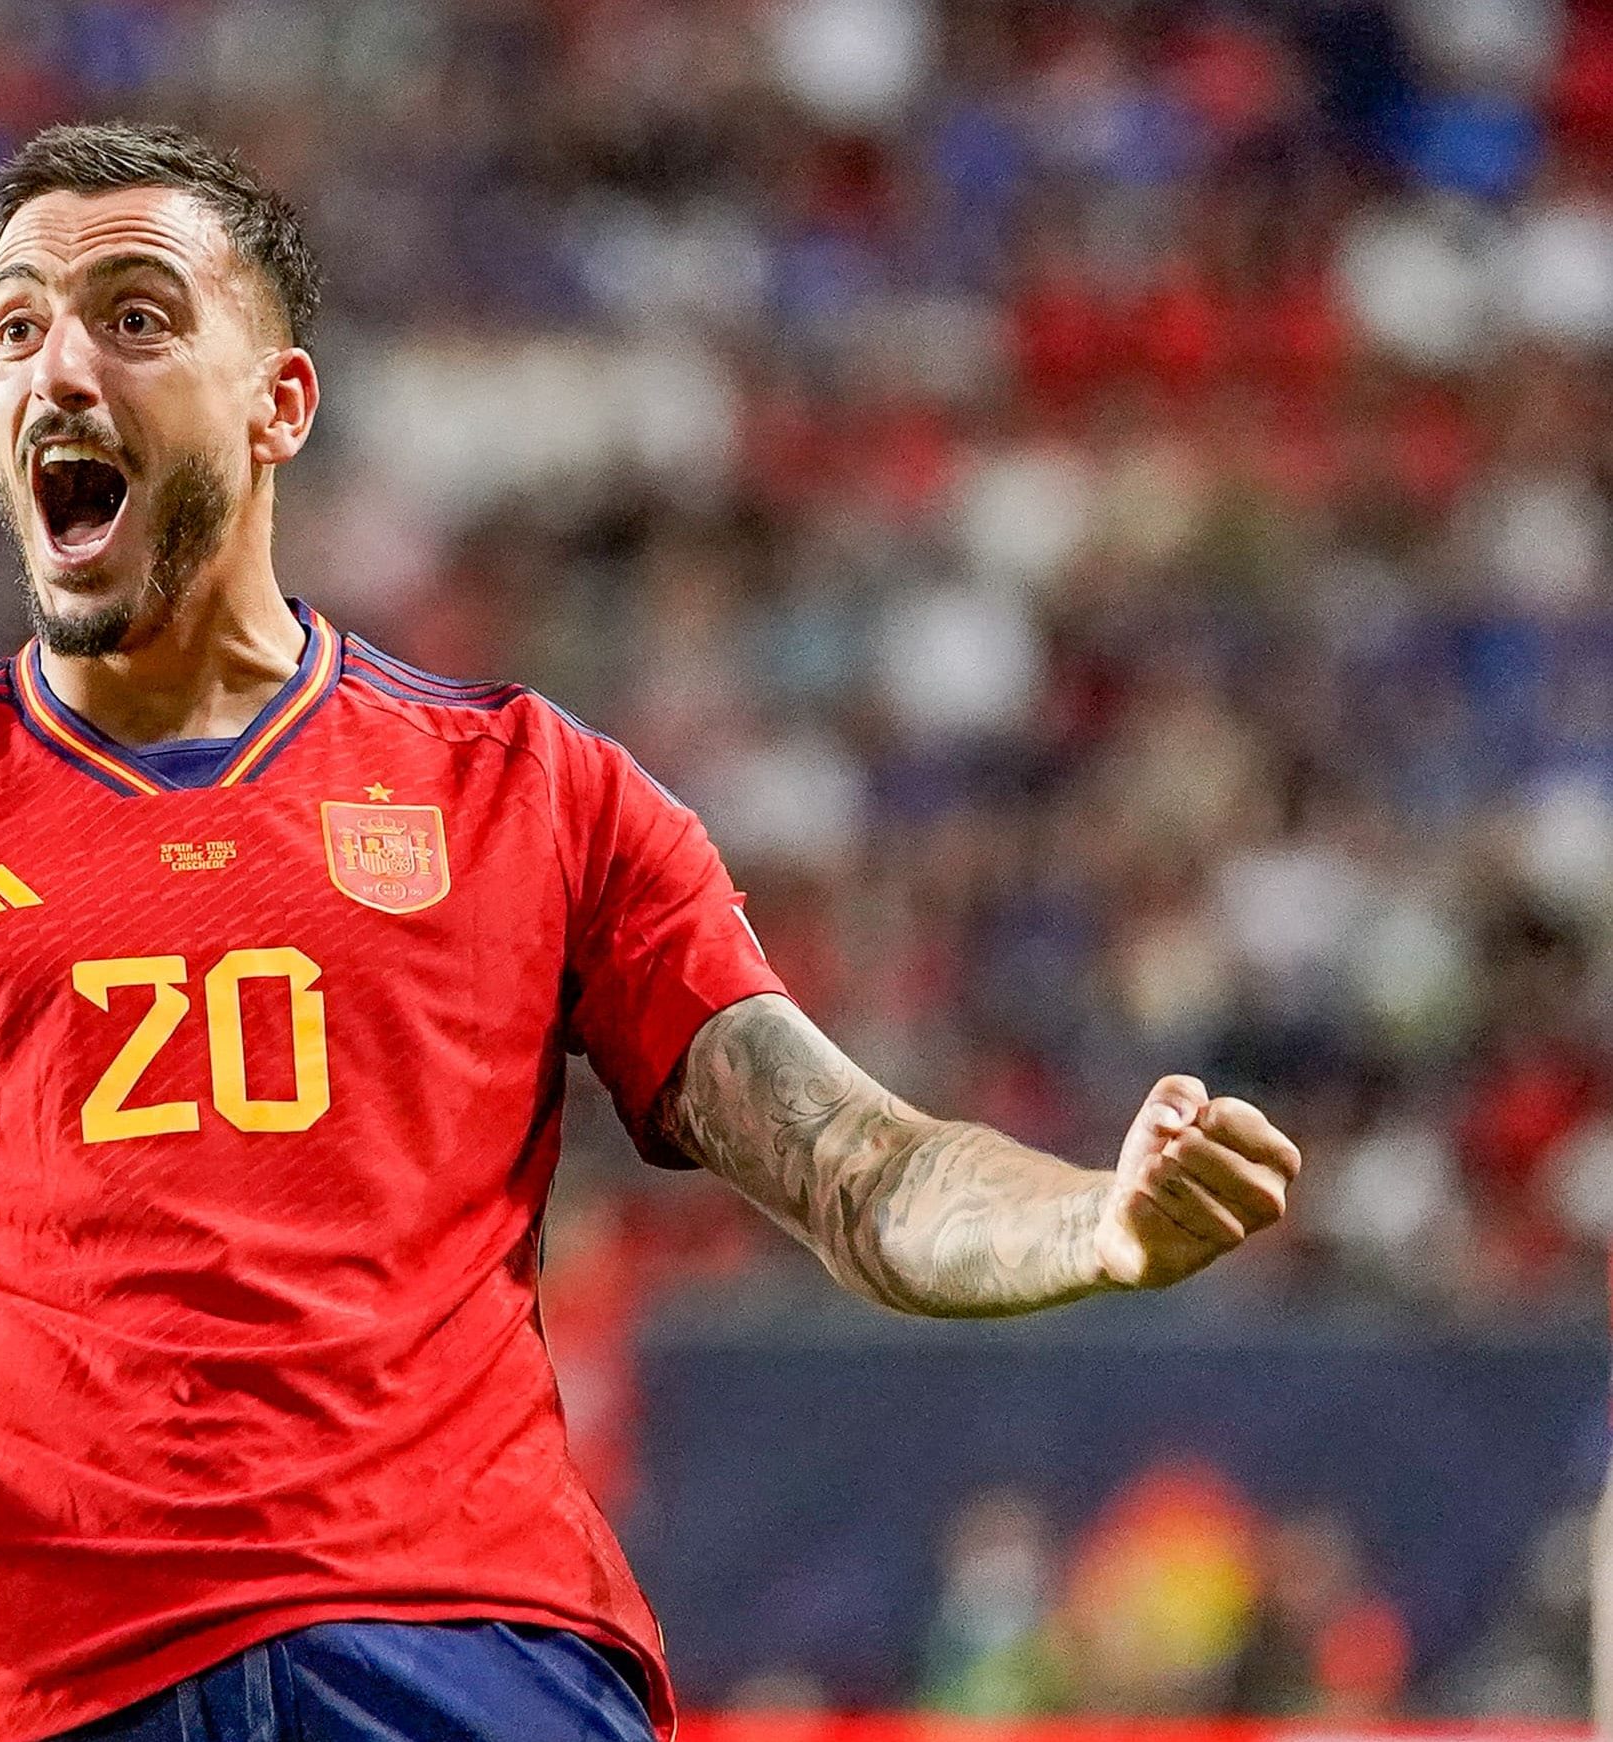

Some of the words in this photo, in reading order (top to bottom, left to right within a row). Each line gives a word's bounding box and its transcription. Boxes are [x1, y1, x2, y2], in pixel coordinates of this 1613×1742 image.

[160, 843, 193, 853] SPAIN
[206, 841, 235, 851] ITALY
[177, 851, 204, 861] JUNE
[71, 946, 331, 1144] 20
